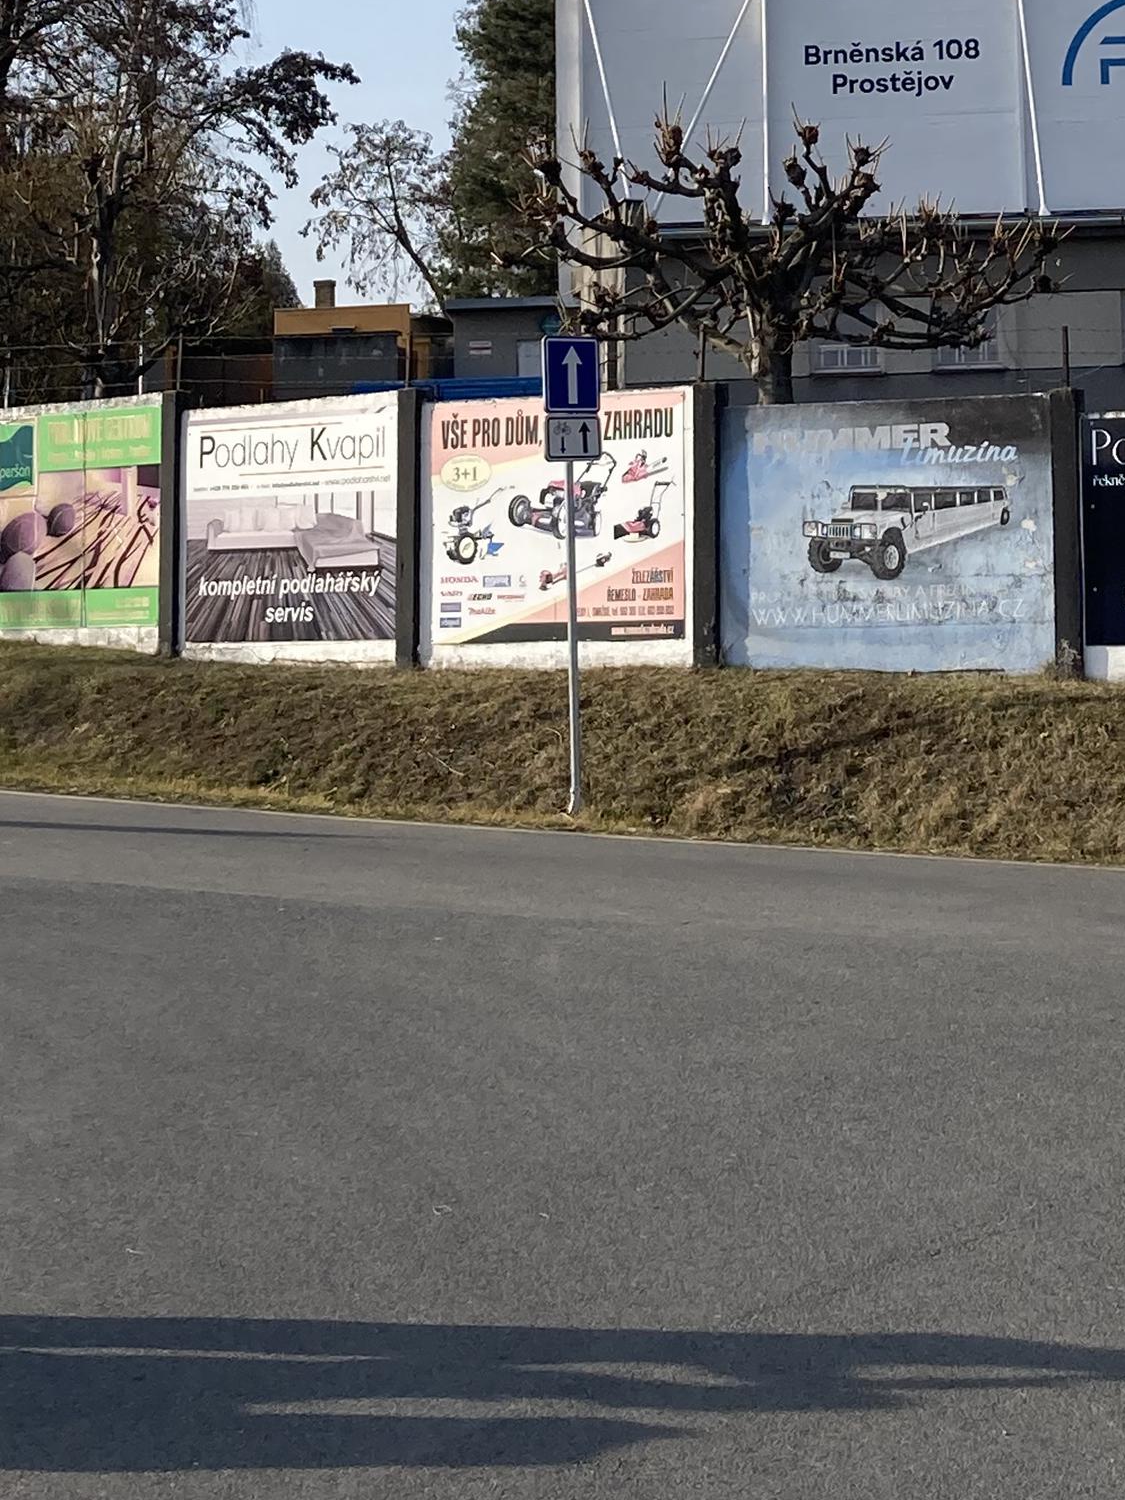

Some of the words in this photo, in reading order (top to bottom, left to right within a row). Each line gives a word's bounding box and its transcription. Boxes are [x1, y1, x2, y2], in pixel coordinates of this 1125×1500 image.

[804, 40, 924, 65] Brněnská
[932, 38, 980, 61] 108
[832, 71, 954, 97] Prostějov
[441, 413, 468, 450] VŠE
[472, 416, 501, 448] PRO
[505, 410, 543, 447] DŮM,
[603, 407, 674, 441] ZAHRADU
[752, 422, 951, 454] UMMER
[200, 433, 299, 470] Podlahy
[310, 426, 385, 466] Kvapil
[452, 467, 478, 482] 3+1
[199, 574, 277, 600] kompletní
[279, 570, 381, 599] podlahářský
[264, 602, 314, 623] servis
